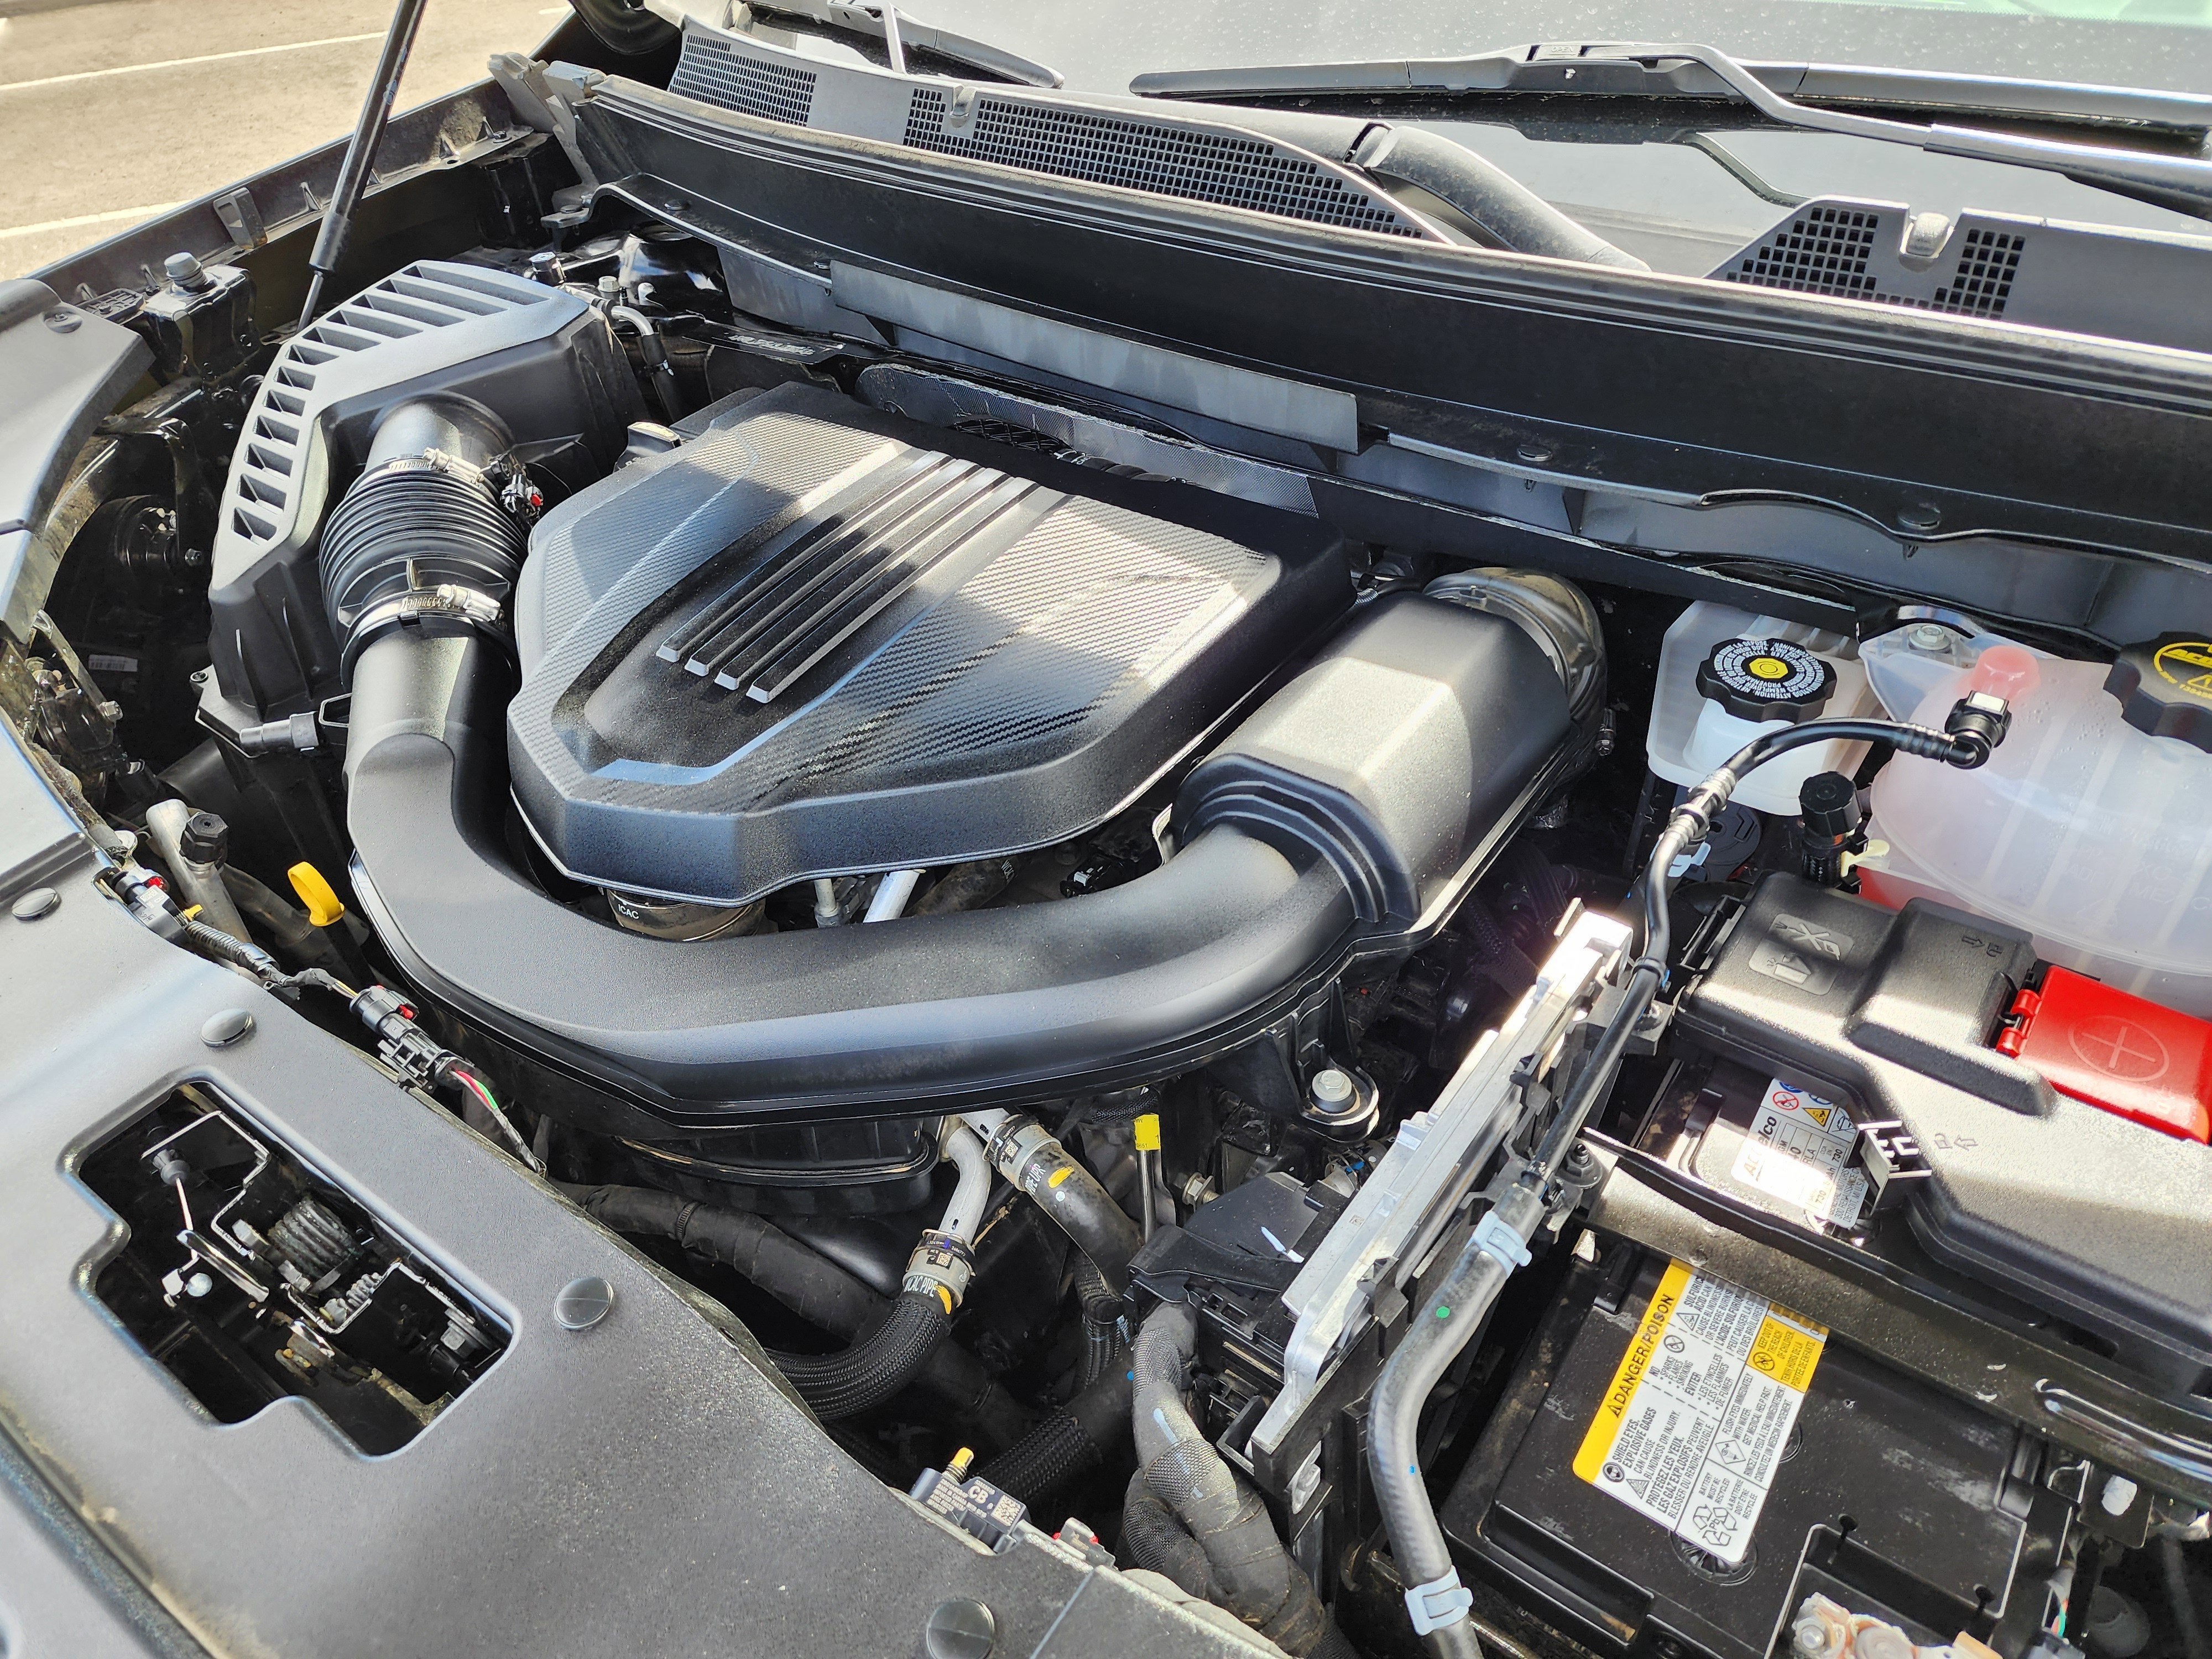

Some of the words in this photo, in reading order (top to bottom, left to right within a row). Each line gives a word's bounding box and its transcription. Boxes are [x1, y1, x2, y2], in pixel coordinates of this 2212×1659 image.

[618, 904, 639, 919] ICAC
[1741, 1115, 1778, 1176] ACelco
[1831, 1148, 1843, 1163] 730
[1835, 1168, 1849, 1191] MOTORS
[1693, 1295, 1707, 1312] ACID
[1700, 1284, 1713, 1297] CAN
[1718, 1288, 1734, 1311] BURNS
[1695, 1315, 1710, 1336] CAUSE
[1703, 1285, 1724, 1318] BLINDNESS
[1709, 1308, 1725, 1332] SEVERE
[1714, 1323, 1731, 1347] L'ACIDE
[1724, 1294, 1745, 1326] SULFURIQ
[1726, 1334, 1740, 1352] PEUT
[1733, 1313, 1750, 1337] CAUSER
[1742, 1304, 1752, 1315] LA
[1765, 1321, 1775, 1329] OF
[1705, 1329, 1715, 1341] OR
[1740, 1334, 1752, 1348] DES
[1757, 1335, 1768, 1349] KEEP
[1762, 1327, 1772, 1338] OUT
[1770, 1329, 1783, 1345] REACH
[1613, 1292, 1674, 1405] DANGER/POISON
[1736, 1345, 1747, 1357] OU
[1766, 1343, 1777, 1354] THE
[1791, 1346, 1801, 1355] DE
[1794, 1340, 1803, 1349] LA
[1776, 1350, 1786, 1360] OF
[1786, 1353, 1798, 1369] HORS
[1648, 1365, 1660, 1377] NO
[1660, 1354, 1676, 1378] SPARKS
[1667, 1358, 1684, 1382] FLAMES
[1676, 1359, 1693, 1386] SMOKING
[1700, 1352, 1723, 1386] ÉTINCELLES
[1780, 1366, 1793, 1383] TENIR
[1682, 1369, 1702, 1396] ÉVITER
[1711, 1361, 1730, 1391] FLAMMES
[1697, 1384, 1709, 1398] LES
[1706, 1389, 1718, 1402] LES
[1719, 1376, 1734, 1396] FUMER
[1733, 1371, 1754, 1405] IMMEDIATELY
[1714, 1394, 1726, 1407] DE
[1755, 1397, 1767, 1413] HELP
[1729, 1403, 1741, 1418] EYES
[1663, 1408, 1681, 1435] INJURY.
[1721, 1416, 1736, 1435] FLUSH
[1745, 1411, 1762, 1436] MEDICAL
[1611, 1436, 1631, 1463] SHIELD
[1623, 1416, 1640, 1439] EYES.
[1622, 1428, 1646, 1469] EXPLOSIVE
[1639, 1406, 1657, 1431] GASES
[1658, 1433, 1670, 1444] OR
[1686, 1416, 1705, 1447] PEUVENT
[1694, 1421, 1715, 1453] AVEUGLE.
[1731, 1424, 1744, 1440] WITH
[1741, 1432, 1754, 1446] GET
[1668, 1433, 1684, 1457] YEUX.
[1750, 1448, 1761, 1460] LES
[1633, 1458, 1646, 1474] CAN
[1640, 1437, 1656, 1460] CAUSE
[1643, 1443, 1666, 1480] BLINDNESS
[1662, 1454, 1675, 1470] LES
[1668, 1444, 1693, 1484] EXPLOSIFS
[1684, 1451, 1702, 1479] RENDRE
[1753, 1454, 1772, 1482] CONSULTEZ
[1764, 1447, 1774, 1457] UN
[1643, 1467, 1670, 1507] PROTÉGEZ
[1662, 1481, 1677, 1499] GAZ
[1679, 1477, 1692, 1490] OU
[1698, 1472, 1713, 1496] BATTERY
[1707, 1483, 1719, 1500] MUST
[1714, 1477, 1731, 1505] RECYCLED
[1728, 1477, 1745, 1504] BATTERIE
[967, 1485, 989, 1504] CB
[1667, 1487, 1687, 1519] BLESSER
[1656, 1496, 1671, 1514] LES
[1726, 1501, 1735, 1511] LA
[1708, 1516, 1720, 1530] Pb
